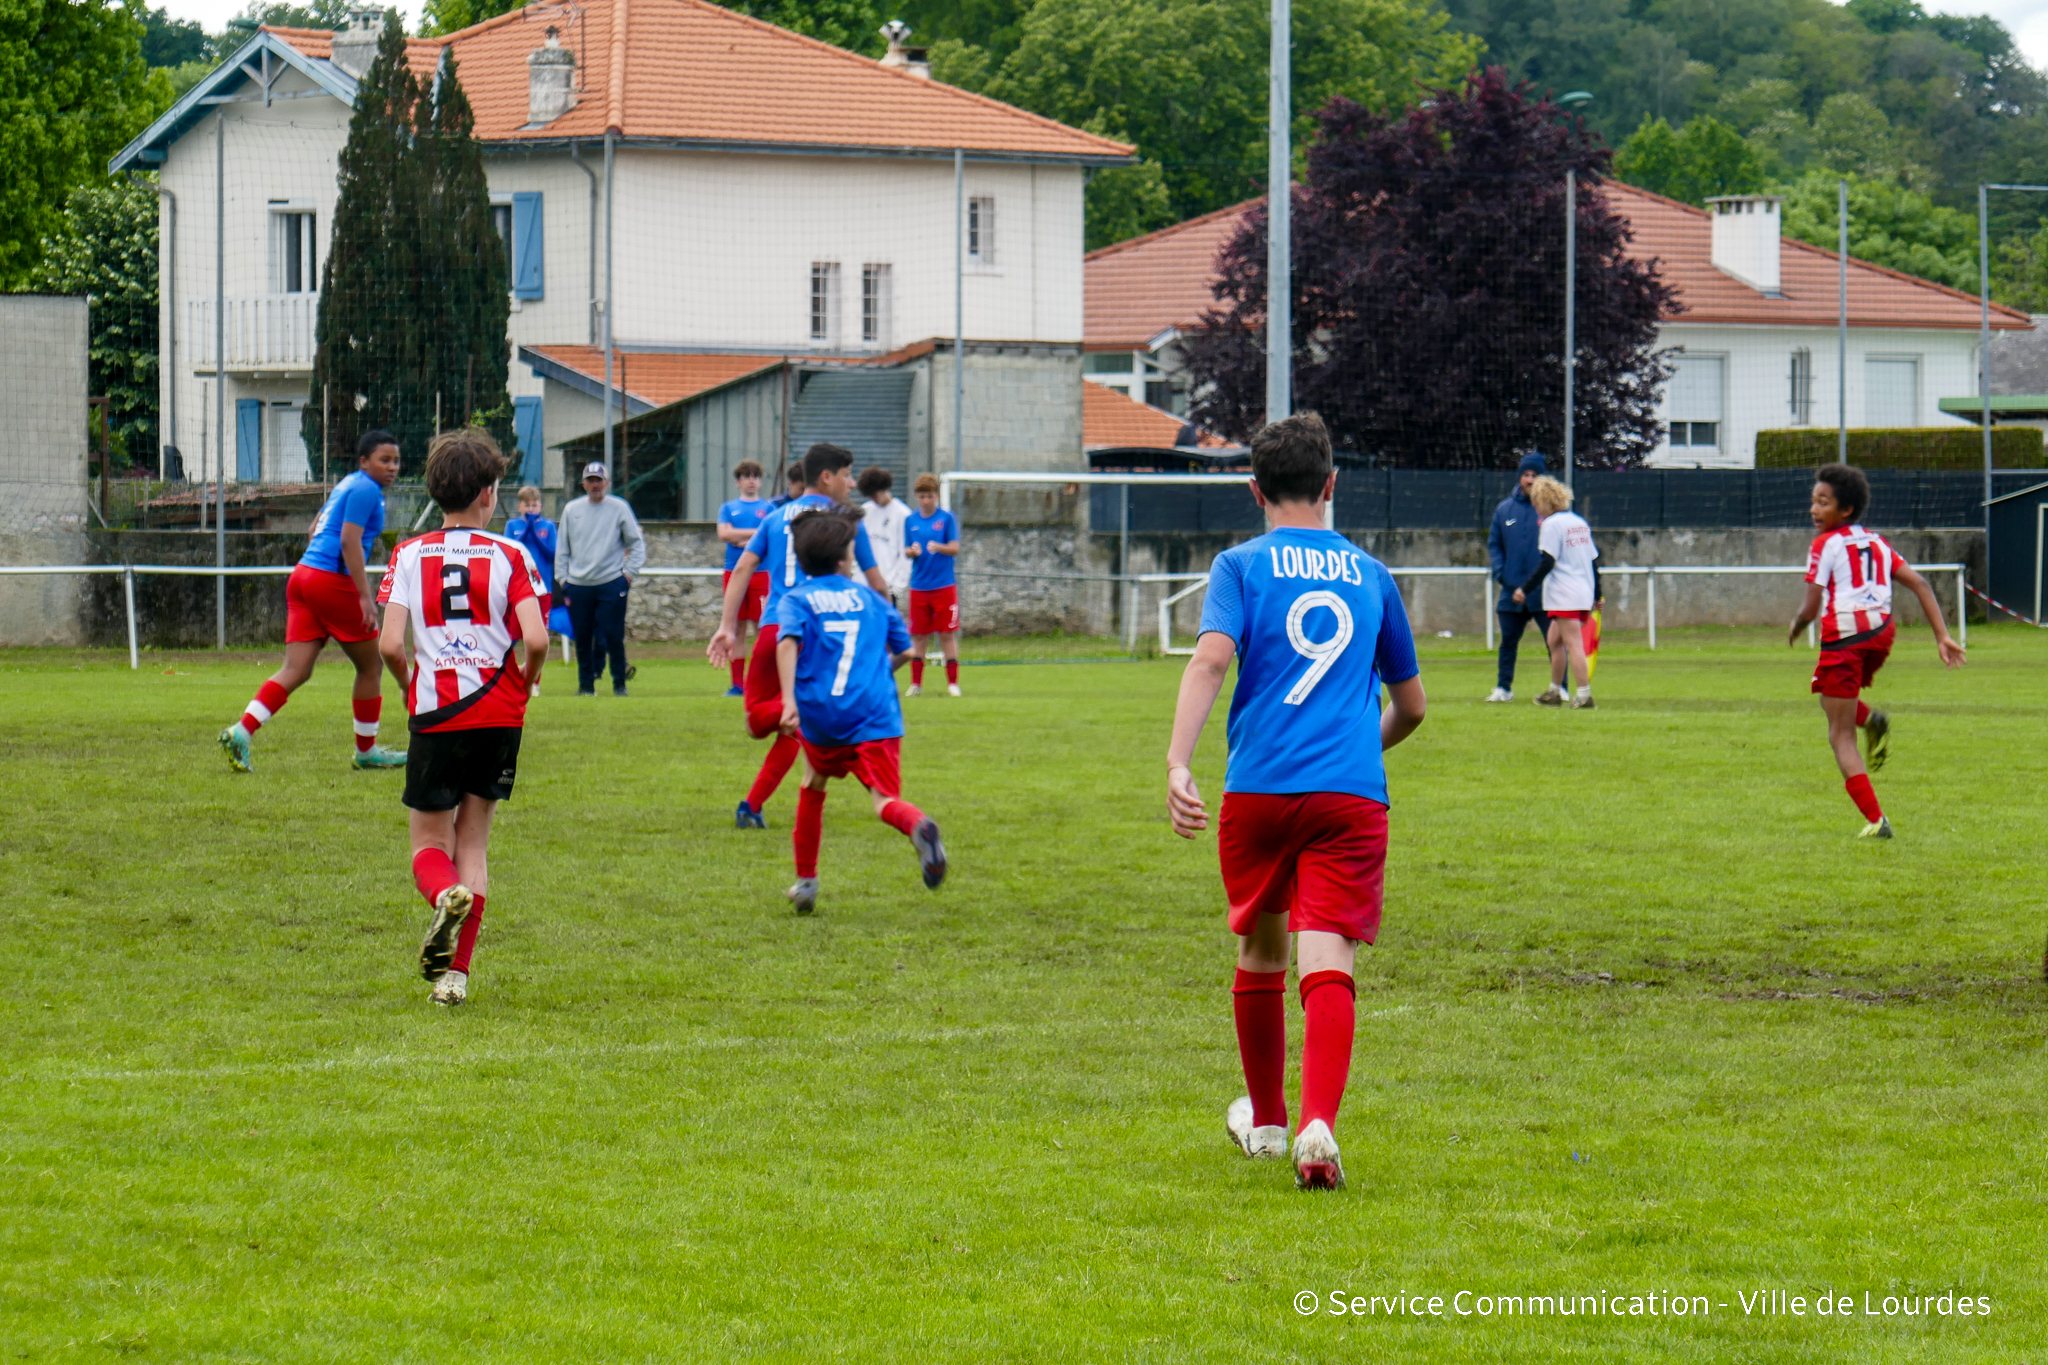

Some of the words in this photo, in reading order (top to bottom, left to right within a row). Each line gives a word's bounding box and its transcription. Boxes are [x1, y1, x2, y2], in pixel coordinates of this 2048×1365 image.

[452, 548, 495, 556] MARQUISAT
[1270, 545, 1363, 586] LOURDES
[440, 564, 474, 620] 2
[823, 620, 860, 696] 7
[1283, 590, 1354, 706] 9
